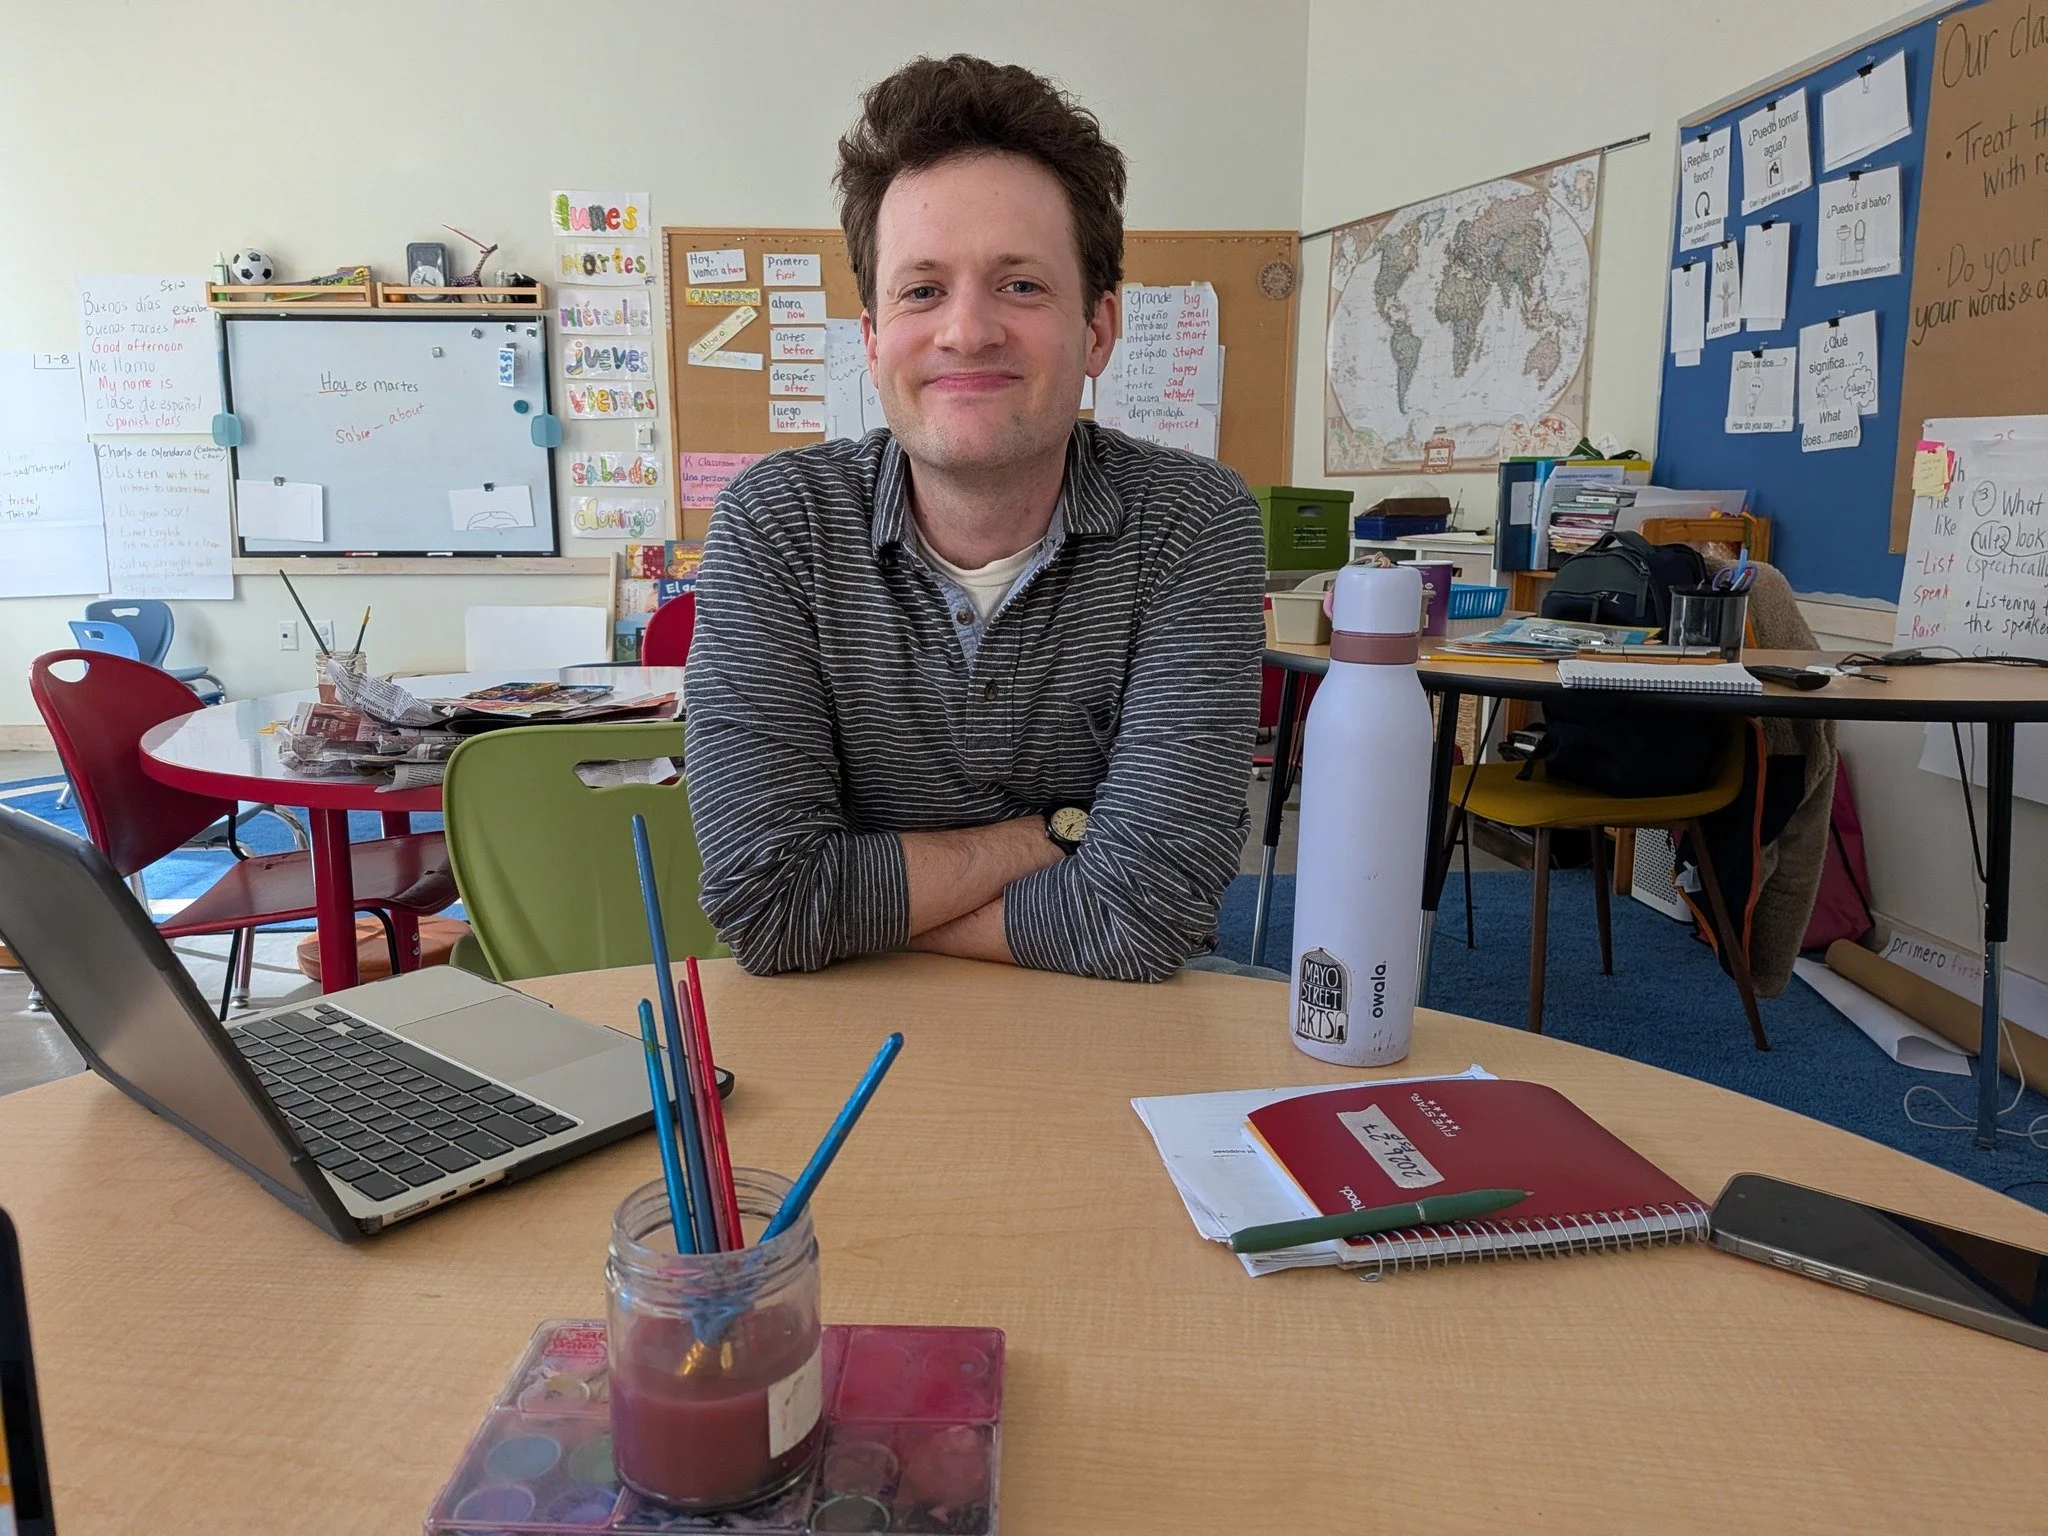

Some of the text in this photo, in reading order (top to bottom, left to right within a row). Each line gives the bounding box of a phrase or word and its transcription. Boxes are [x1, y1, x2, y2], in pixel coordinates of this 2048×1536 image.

[1942, 3, 2048, 88] Our cla
[1778, 110, 1801, 129] tomar
[1763, 135, 1788, 158] agua?
[1955, 112, 2018, 165] Treat
[1713, 145, 1726, 160] por
[1983, 154, 2026, 199] with
[1826, 203, 1854, 219] ¿Puedo
[1854, 201, 1861, 212] ir
[1861, 198, 1868, 210] al
[1948, 236, 2042, 293] Do your
[82, 291, 161, 316] Buenos días
[771, 298, 804, 310] ahora
[1130, 290, 1201, 314] grande big
[786, 311, 806, 320] now
[1128, 309, 1209, 327] pequeño small
[1911, 280, 2034, 347] your words &
[131, 322, 169, 335] tardes
[774, 331, 806, 343] antes
[1175, 330, 1207, 342] smart
[92, 336, 184, 354] Good afternoon
[783, 345, 815, 356] before
[1128, 346, 1168, 361] estúpido
[1823, 334, 1849, 355] ¿Qué
[43, 354, 70, 365] 7-8
[90, 356, 155, 375] Me llamo
[566, 340, 650, 377] jueves
[772, 369, 817, 389] después
[1171, 362, 1198, 378] happy
[98, 375, 174, 398] My name is
[320, 371, 354, 398] Hoy
[356, 379, 370, 392] es
[1124, 376, 1185, 390] triste sad
[96, 394, 203, 414] clase de español
[569, 384, 656, 414] viernes
[105, 413, 182, 431] Spanish class
[388, 403, 425, 425] about
[772, 403, 802, 422] luego
[1819, 409, 1841, 425] What
[1158, 418, 1200, 433] depressed
[137, 448, 149, 459] de
[684, 455, 694, 468] K
[115, 465, 212, 481] Listen with the
[572, 455, 659, 486] sábado
[2002, 487, 2046, 517] What
[574, 498, 658, 539] domingo
[1934, 514, 1959, 536] like
[2016, 521, 2046, 549] look
[666, 580, 681, 595] El
[1963, 612, 1993, 634] the
[1885, 937, 1946, 968] primero
[1303, 960, 1340, 988] MAYO
[1301, 981, 1341, 1010] STREET
[1300, 1002, 1336, 1041] ARTS
[1430, 1117, 1457, 1139] FIVE
